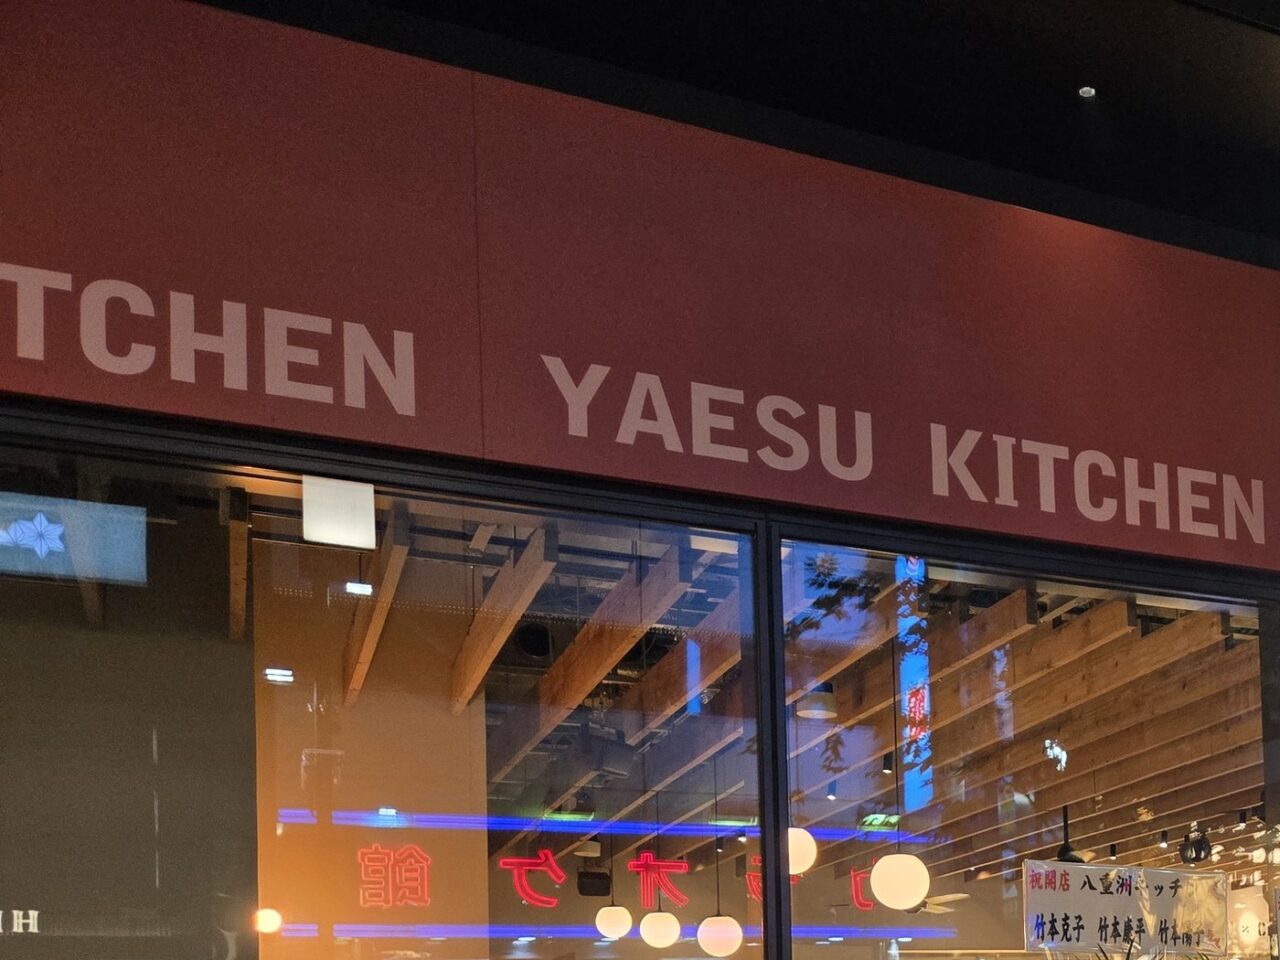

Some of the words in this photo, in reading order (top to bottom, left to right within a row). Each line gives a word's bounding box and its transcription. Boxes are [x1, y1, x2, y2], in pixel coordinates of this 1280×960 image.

[0, 262, 416, 416] TCHEN
[540, 354, 874, 482] YAESU
[930, 422, 1266, 545] KITCHEN
[1029, 869, 1071, 892] 祝開店
[1034, 912, 1085, 943] 竹本克子
